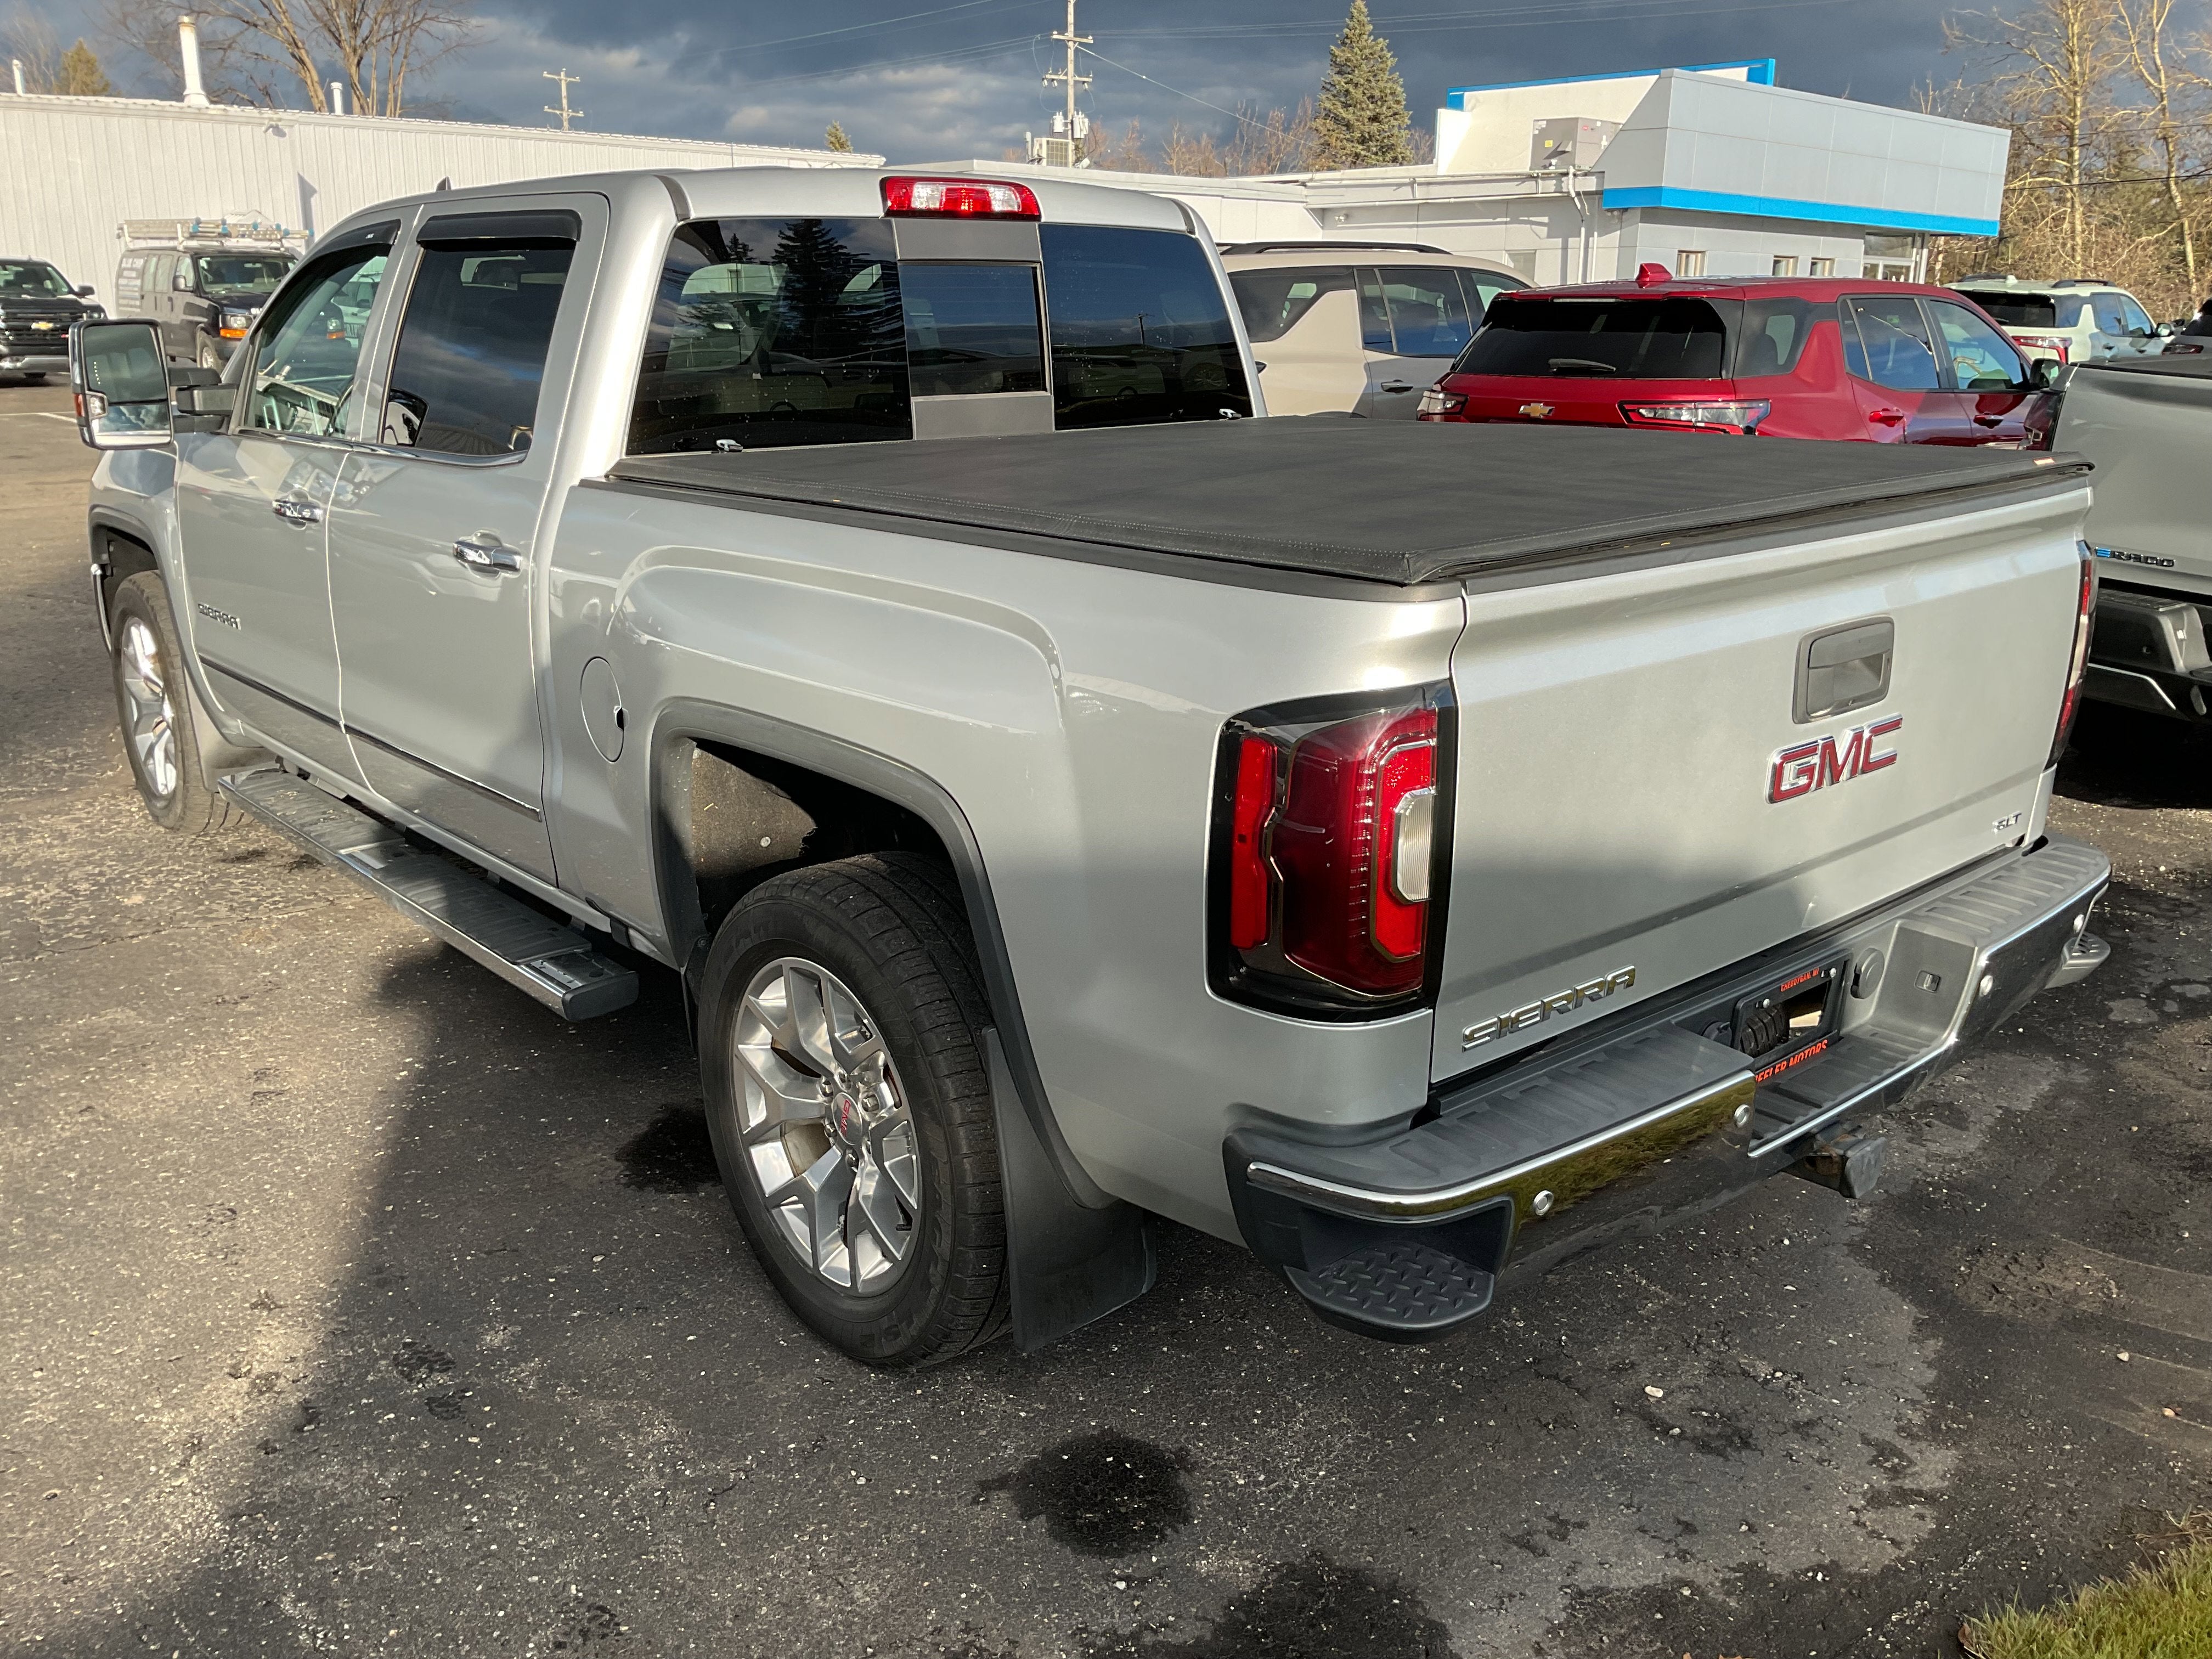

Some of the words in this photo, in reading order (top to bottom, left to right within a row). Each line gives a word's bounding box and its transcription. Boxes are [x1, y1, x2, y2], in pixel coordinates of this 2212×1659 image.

[198, 603, 241, 630] SIERRA
[1765, 712, 1903, 804] GMC
[1992, 811, 2022, 833] SLT
[1462, 964, 1635, 1052] SIERRA
[1789, 1039, 1827, 1066] MOTORS
[840, 1098, 851, 1138] GMC
